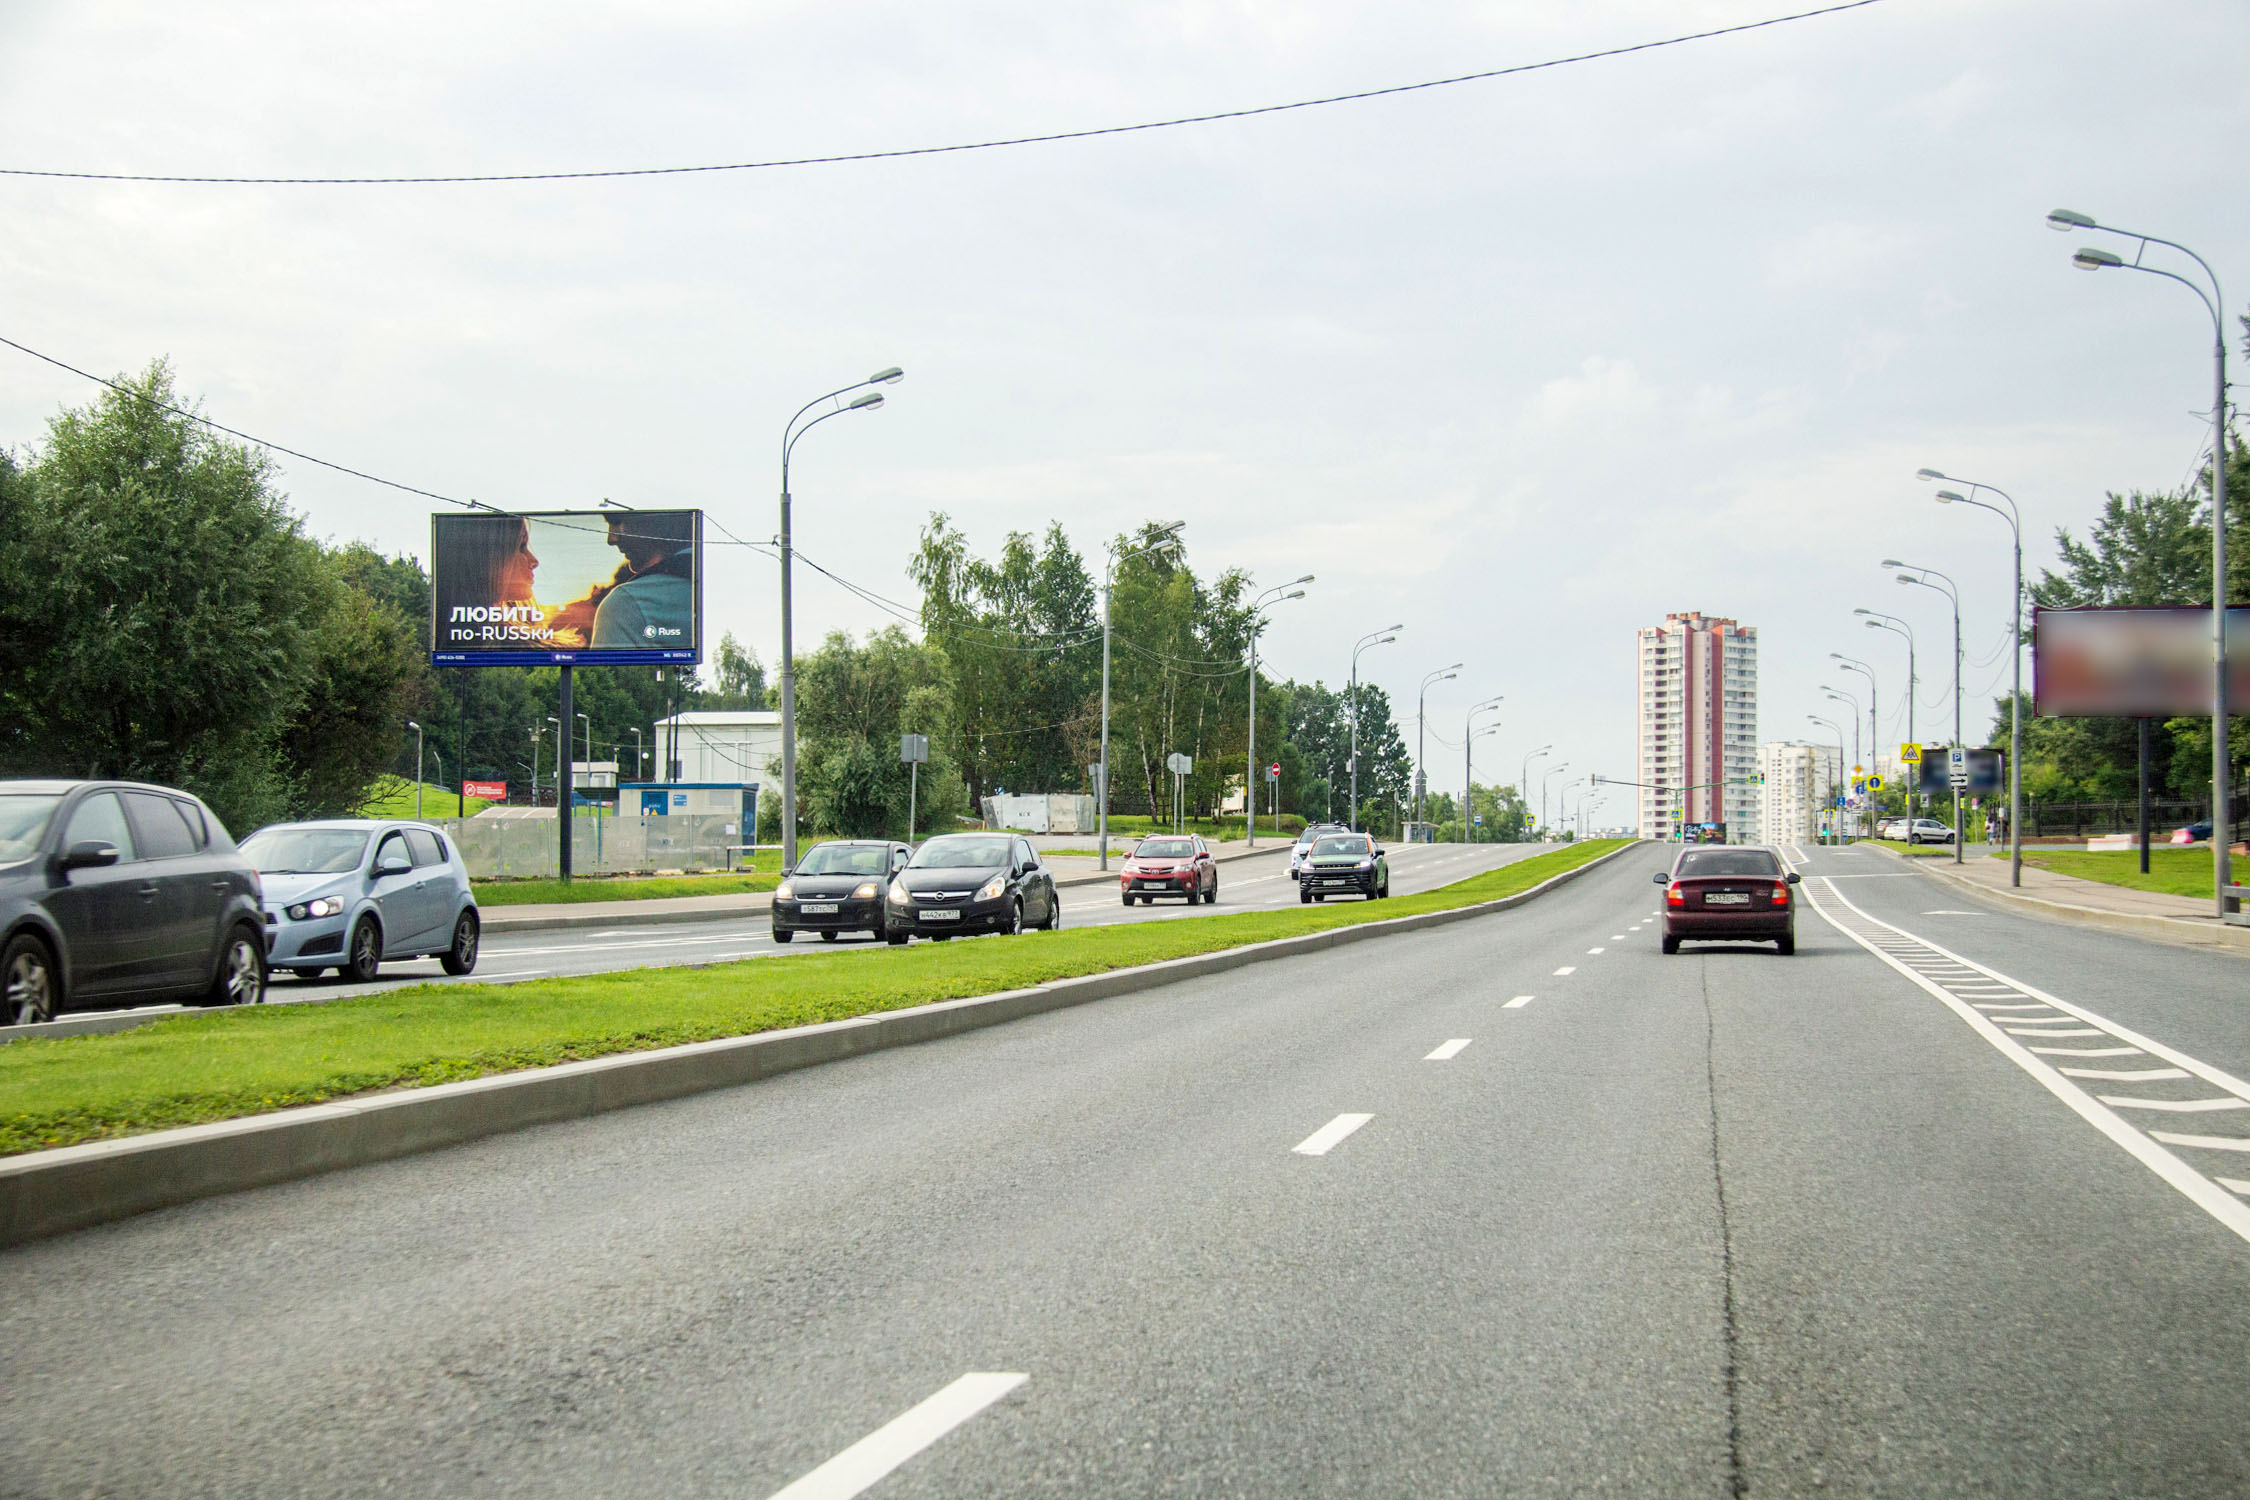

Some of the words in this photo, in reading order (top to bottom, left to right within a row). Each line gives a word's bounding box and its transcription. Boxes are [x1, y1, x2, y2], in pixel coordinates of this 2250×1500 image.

[450, 606, 545, 623] ЛЮБИТЬ
[450, 625, 554, 641] по-RUSSки
[658, 626, 681, 636] Russ
